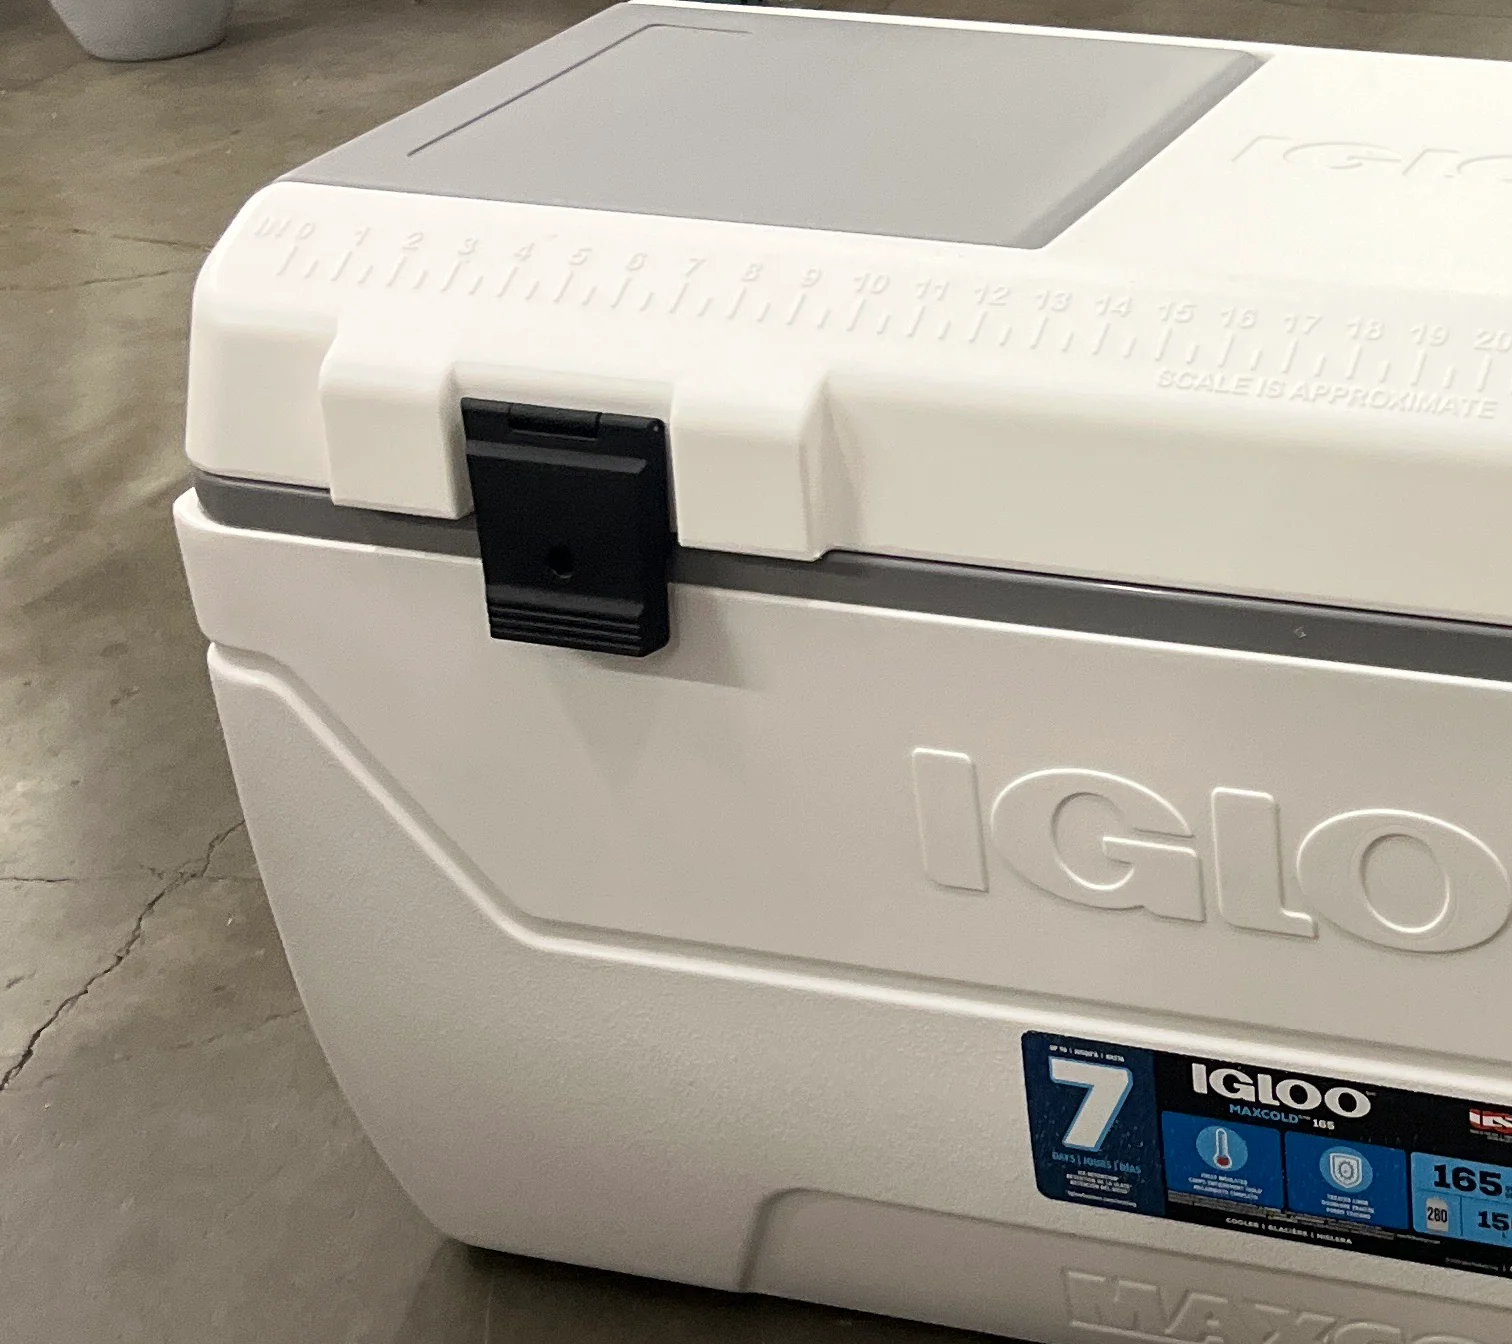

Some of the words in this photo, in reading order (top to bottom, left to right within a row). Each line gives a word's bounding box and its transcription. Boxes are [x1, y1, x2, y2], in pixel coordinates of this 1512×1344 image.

[295, 221, 317, 241] 0
[354, 226, 371, 246] 1
[402, 231, 424, 251] 2
[457, 235, 480, 256] 3
[514, 241, 537, 261] 4
[568, 246, 593, 267] 5
[625, 251, 648, 272] 6
[682, 257, 706, 276] 7
[740, 262, 763, 283] 8
[800, 266, 824, 288] 9
[852, 271, 891, 295] 10
[914, 277, 950, 301] 11
[973, 283, 1010, 307] 12
[1033, 289, 1074, 312] 13
[1094, 295, 1133, 318] 14
[1156, 301, 1197, 325] 15
[1219, 306, 1260, 330] 16
[1282, 312, 1323, 336] 17
[1345, 318, 1386, 342] 18
[1409, 323, 1449, 347] 19
[1157, 368, 1252, 396] SCALE
[1255, 373, 1287, 399] IS
[1289, 377, 1501, 420] APPROXIMATE
[1048, 1056, 1134, 1152] 7
[1191, 1062, 1372, 1118] IGLOO
[1229, 1104, 1299, 1124] MAXCOLD
[1312, 1119, 1335, 1130] 165
[1433, 1163, 1503, 1197] 165
[1225, 1217, 1260, 1229] COOLER
[1427, 1206, 1448, 1224] 280
